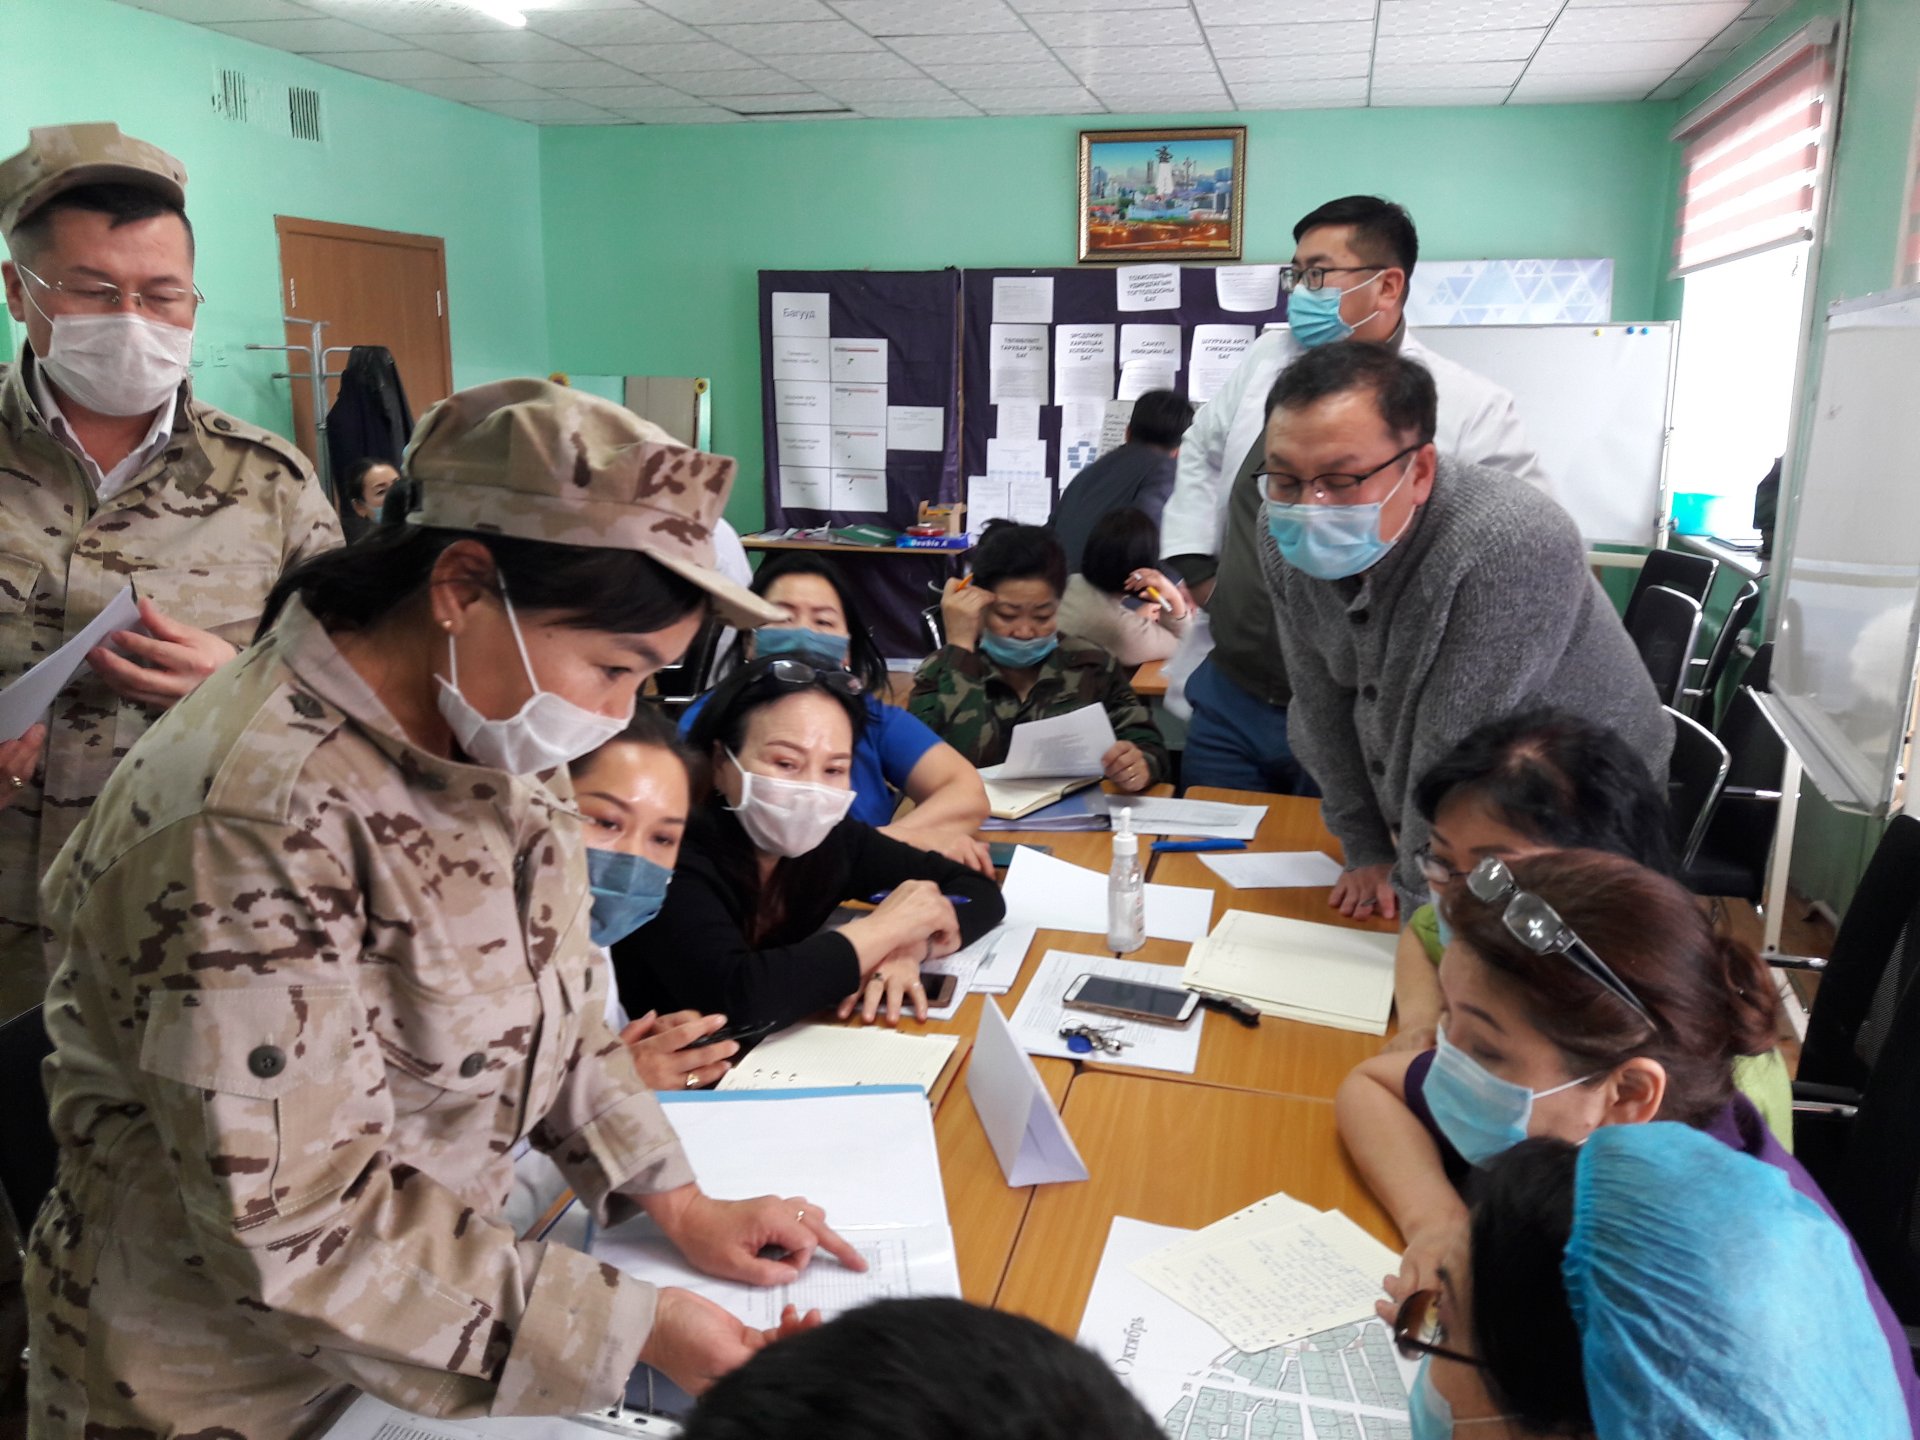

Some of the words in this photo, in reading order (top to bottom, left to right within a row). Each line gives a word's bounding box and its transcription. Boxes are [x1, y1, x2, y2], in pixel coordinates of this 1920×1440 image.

[783, 307, 816, 320] Багууд
[911, 539, 940, 547] Double
[1113, 1317, 1147, 1376] Октябрь
